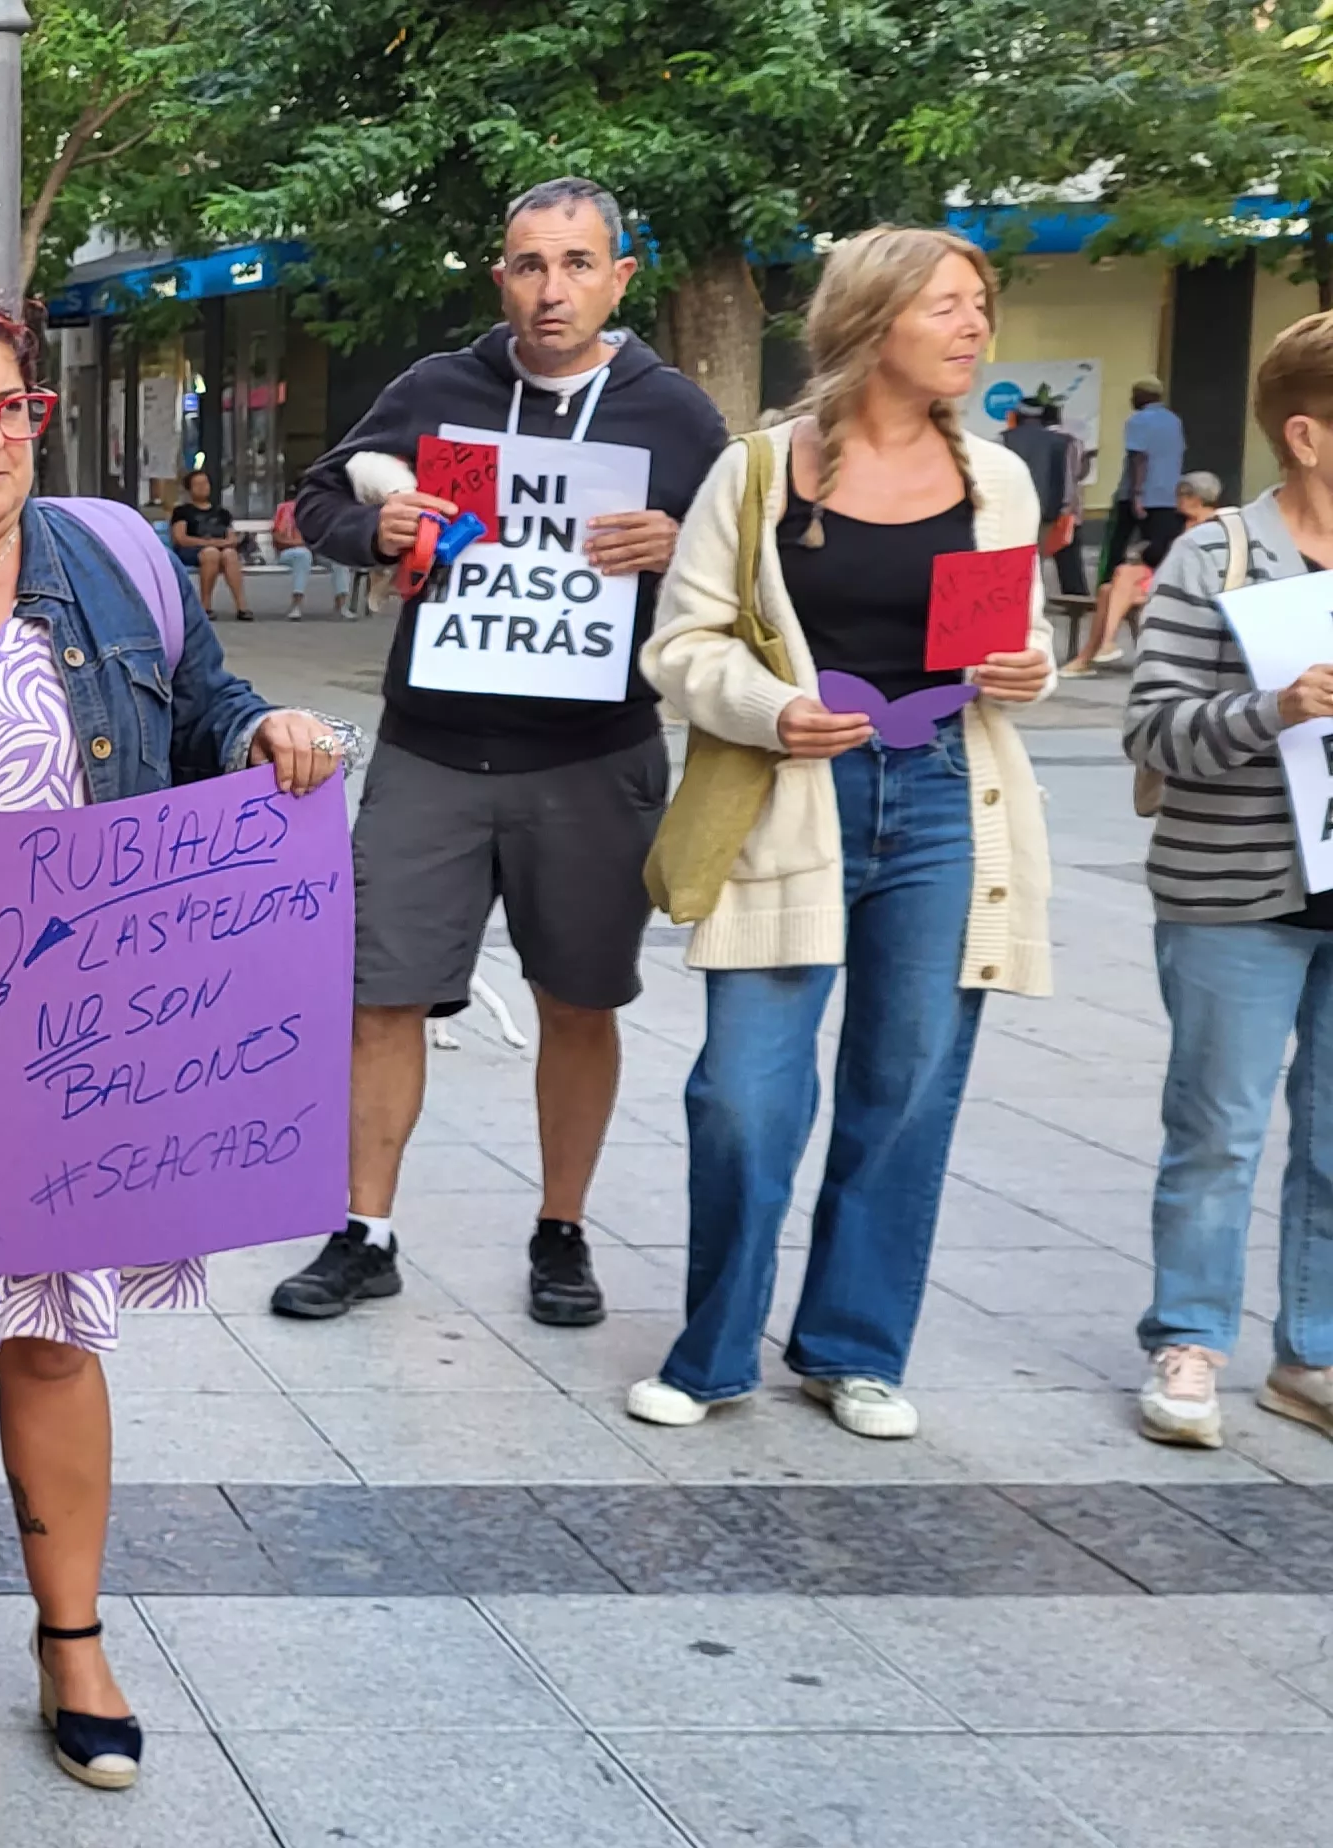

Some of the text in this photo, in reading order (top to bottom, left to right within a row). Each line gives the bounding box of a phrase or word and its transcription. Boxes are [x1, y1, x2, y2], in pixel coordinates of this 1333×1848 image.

[510, 473, 567, 505] NI
[499, 515, 577, 553] UN
[457, 562, 602, 603] PASO
[433, 608, 615, 658] ATRÁS
[77, 912, 169, 971] LAS
[36, 968, 232, 1051] NO SON
[44, 1013, 302, 1121] BALONES
[29, 1102, 318, 1216] #SEACABÓ
